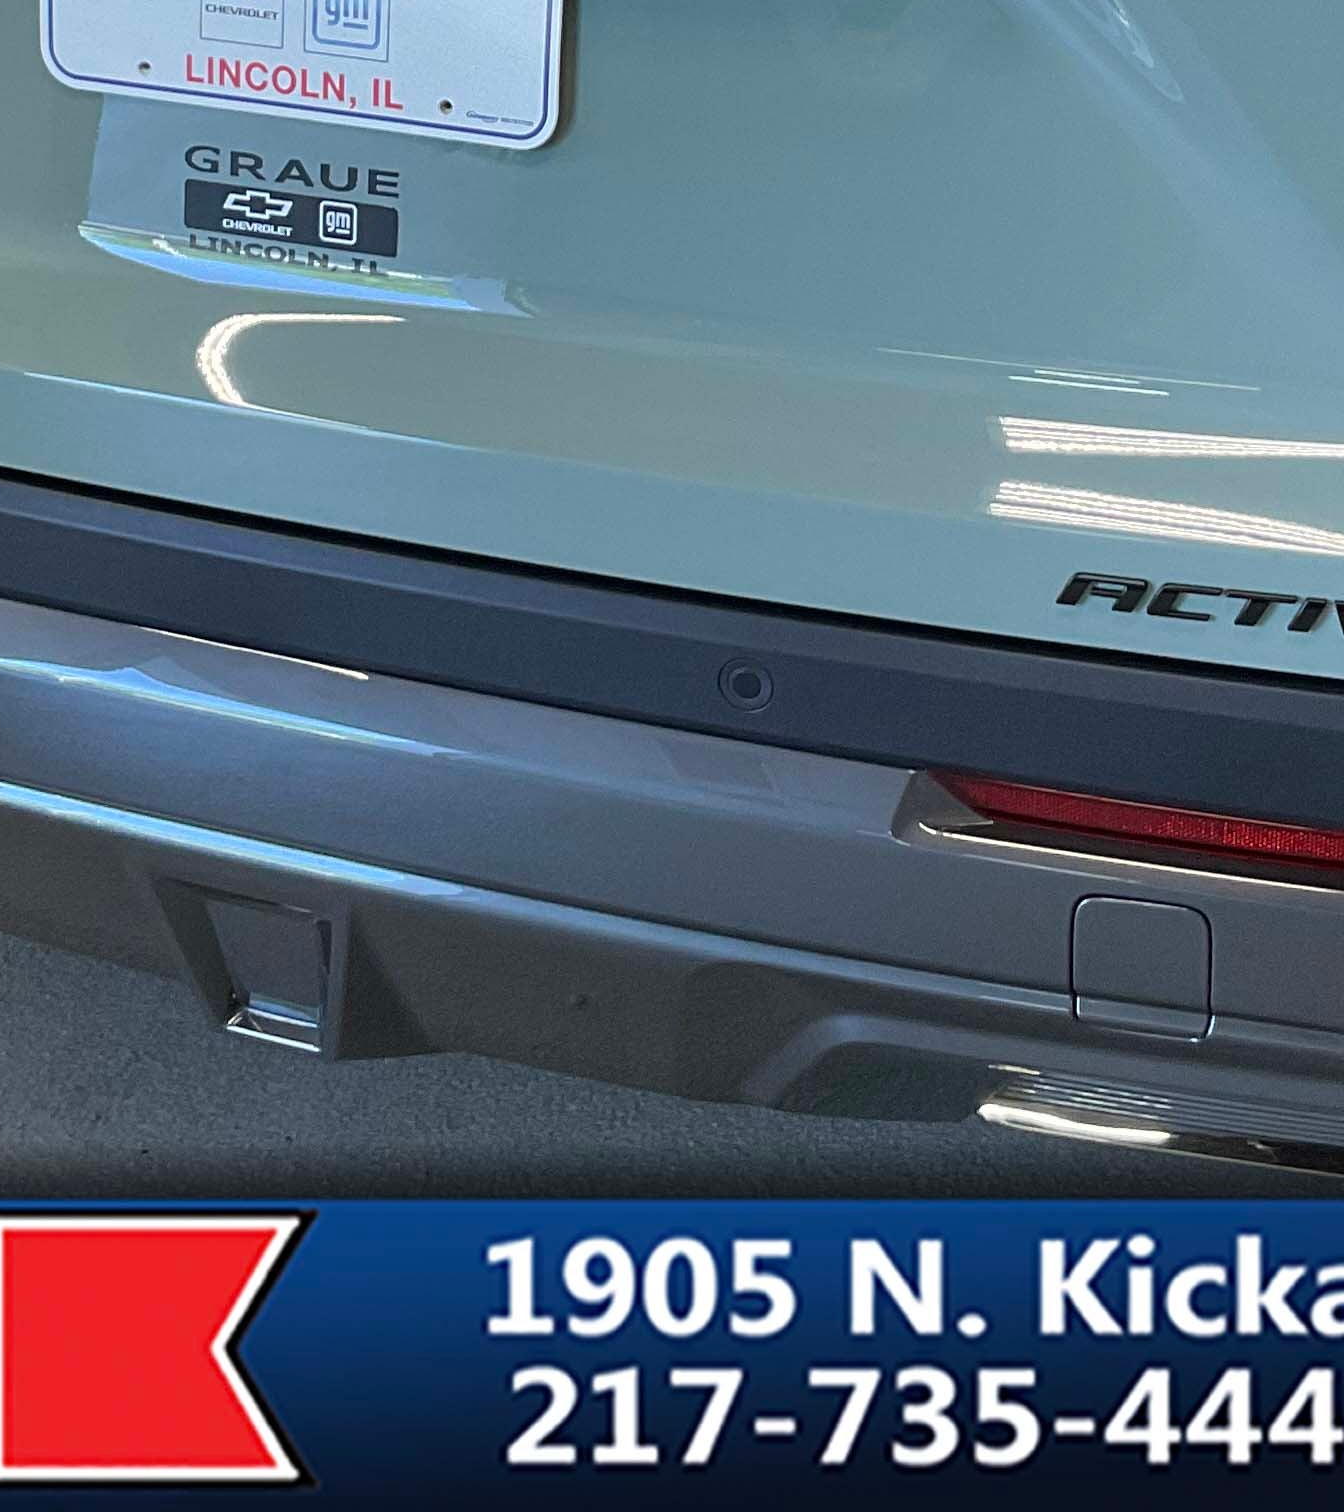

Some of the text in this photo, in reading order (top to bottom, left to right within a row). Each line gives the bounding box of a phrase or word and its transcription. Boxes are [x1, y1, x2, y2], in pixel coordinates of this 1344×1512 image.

[205, 2, 279, 21] CHEVROLET
[186, 53, 404, 110] LINCOLN, IL
[184, 145, 399, 199] GRAUE
[222, 218, 293, 237] CHEVROLET
[325, 210, 351, 234] gm
[352, 257, 389, 276] IL
